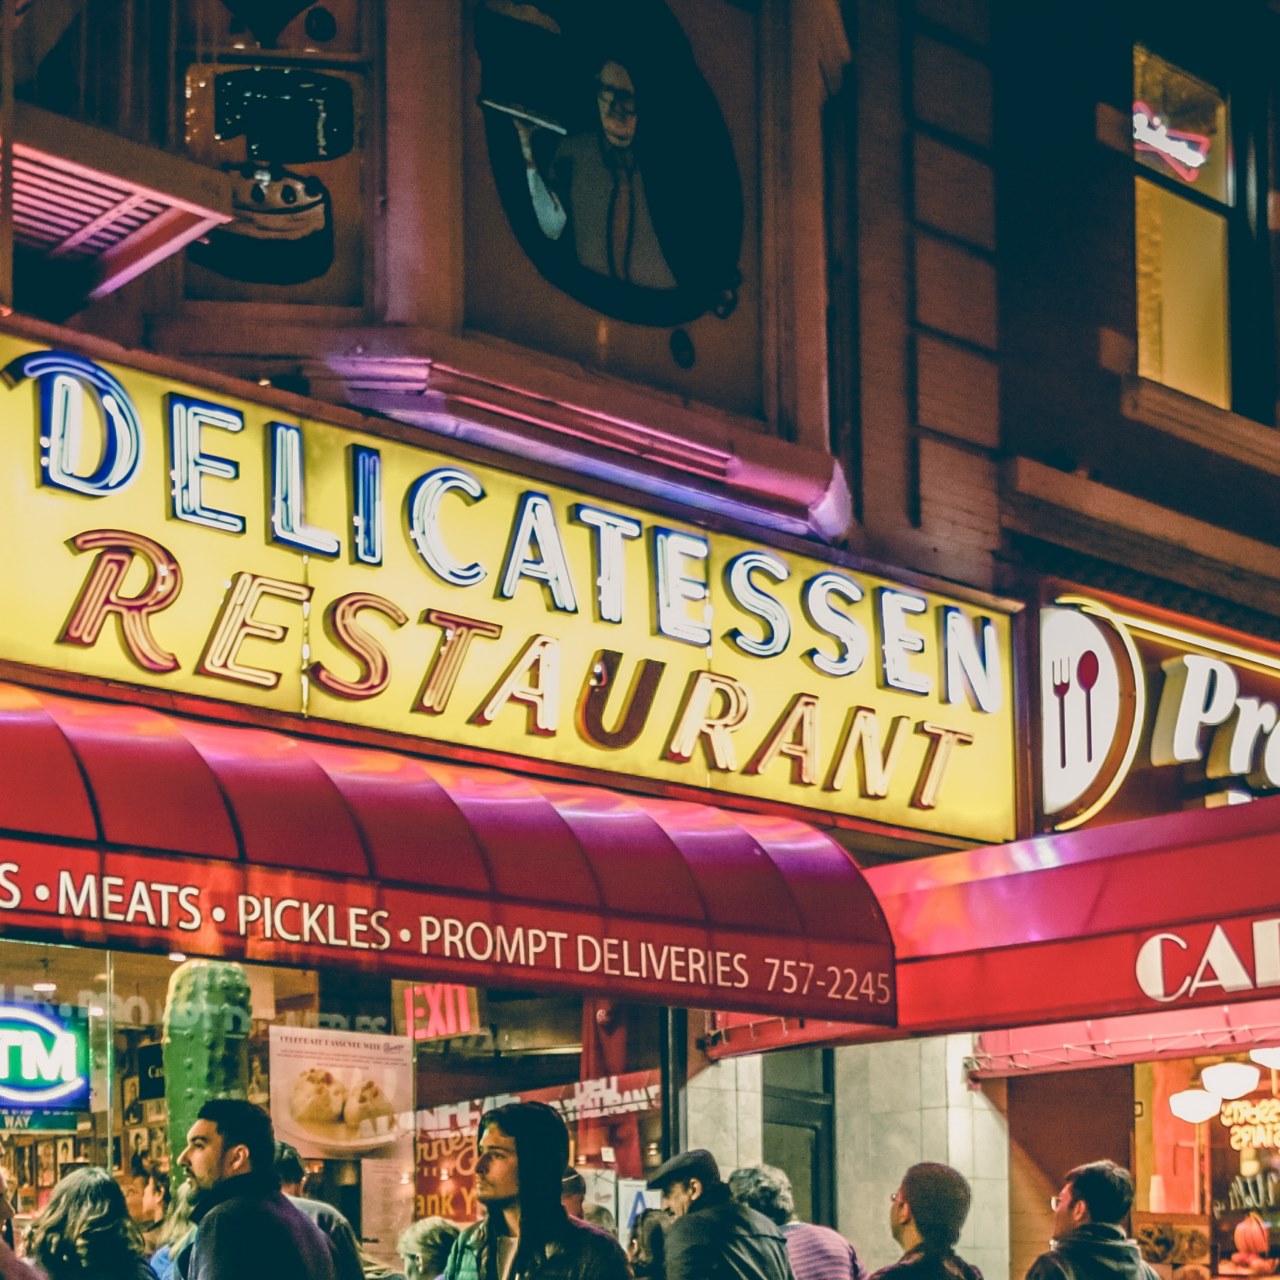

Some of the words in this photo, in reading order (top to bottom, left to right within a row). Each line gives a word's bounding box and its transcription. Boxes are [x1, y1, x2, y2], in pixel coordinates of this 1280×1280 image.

[0, 349, 1002, 716] DELICATESSEN
[58, 527, 976, 812] RESTAURANT
[57, 868, 202, 931] MEATS
[237, 892, 391, 950] PICKLES
[420, 914, 569, 970] PROMPT
[576, 934, 750, 988] DELIVERIES
[763, 957, 891, 1005] 757-2245
[403, 982, 473, 1041] EXIT
[148, 1065, 164, 1079] Cas
[3, 1115, 31, 1129] WAY
[416, 1192, 455, 1216] ank
[627, 1190, 648, 1229] A
